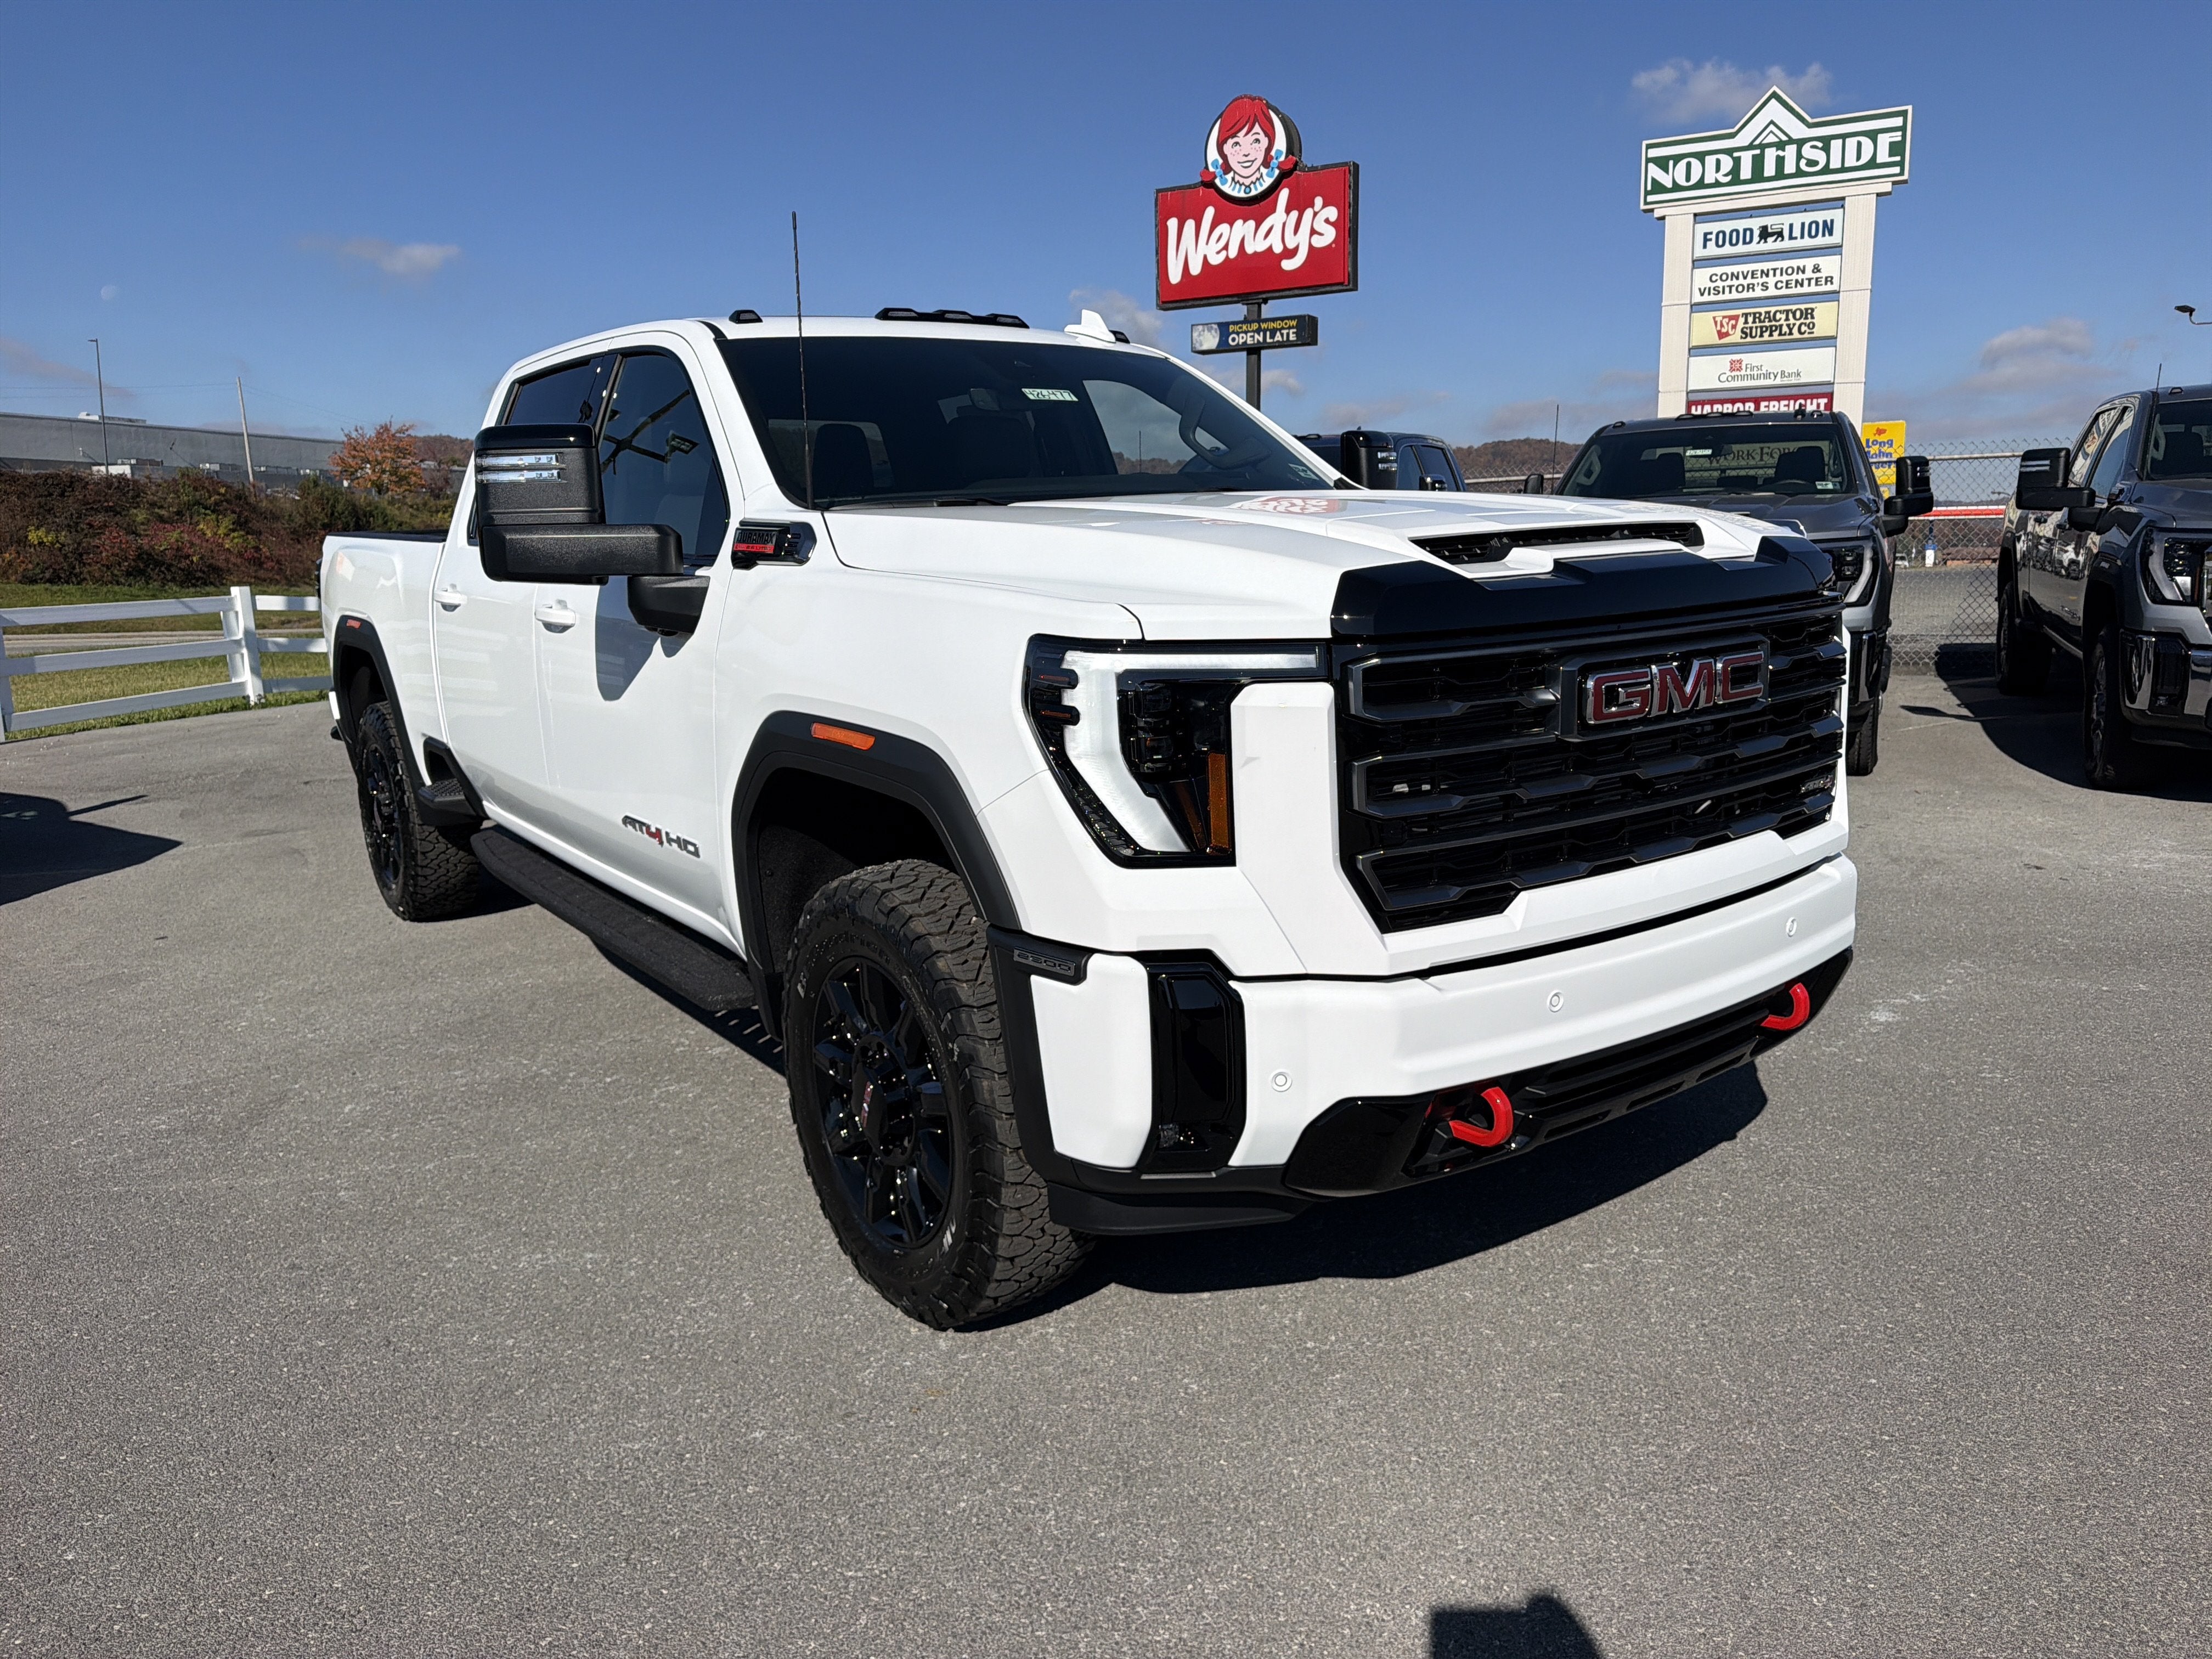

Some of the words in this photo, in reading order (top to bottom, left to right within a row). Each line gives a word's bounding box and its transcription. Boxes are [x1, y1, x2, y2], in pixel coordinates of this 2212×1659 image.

[1647, 131, 1903, 191] NORTHSIDE
[1166, 188, 1339, 284] Wendy's
[1702, 227, 1754, 249] FOOD
[1788, 218, 1835, 241] LION
[1709, 264, 1806, 283] CONVENTION
[1812, 263, 1822, 274] &
[1698, 281, 1769, 297] VISITOR'S
[1774, 275, 1834, 290] CENTER
[1741, 307, 1815, 325] TRACTOR
[1229, 323, 1259, 332] PICKUP
[1260, 319, 1297, 329] WINDOW
[1715, 317, 1736, 335] TSC
[1740, 322, 1796, 340] SUPPLY
[1228, 331, 1263, 346] OPEN
[1266, 329, 1297, 343] LATE
[1718, 369, 1779, 383] Community
[1780, 368, 1802, 380] Bank
[1745, 363, 1763, 372] First
[1866, 438, 1893, 448] Long
[736, 530, 777, 544] DURAMAX
[1587, 651, 1764, 724] GMC
[622, 815, 664, 848] AT4
[665, 831, 701, 858] HD
[1017, 951, 1071, 972] 2500
